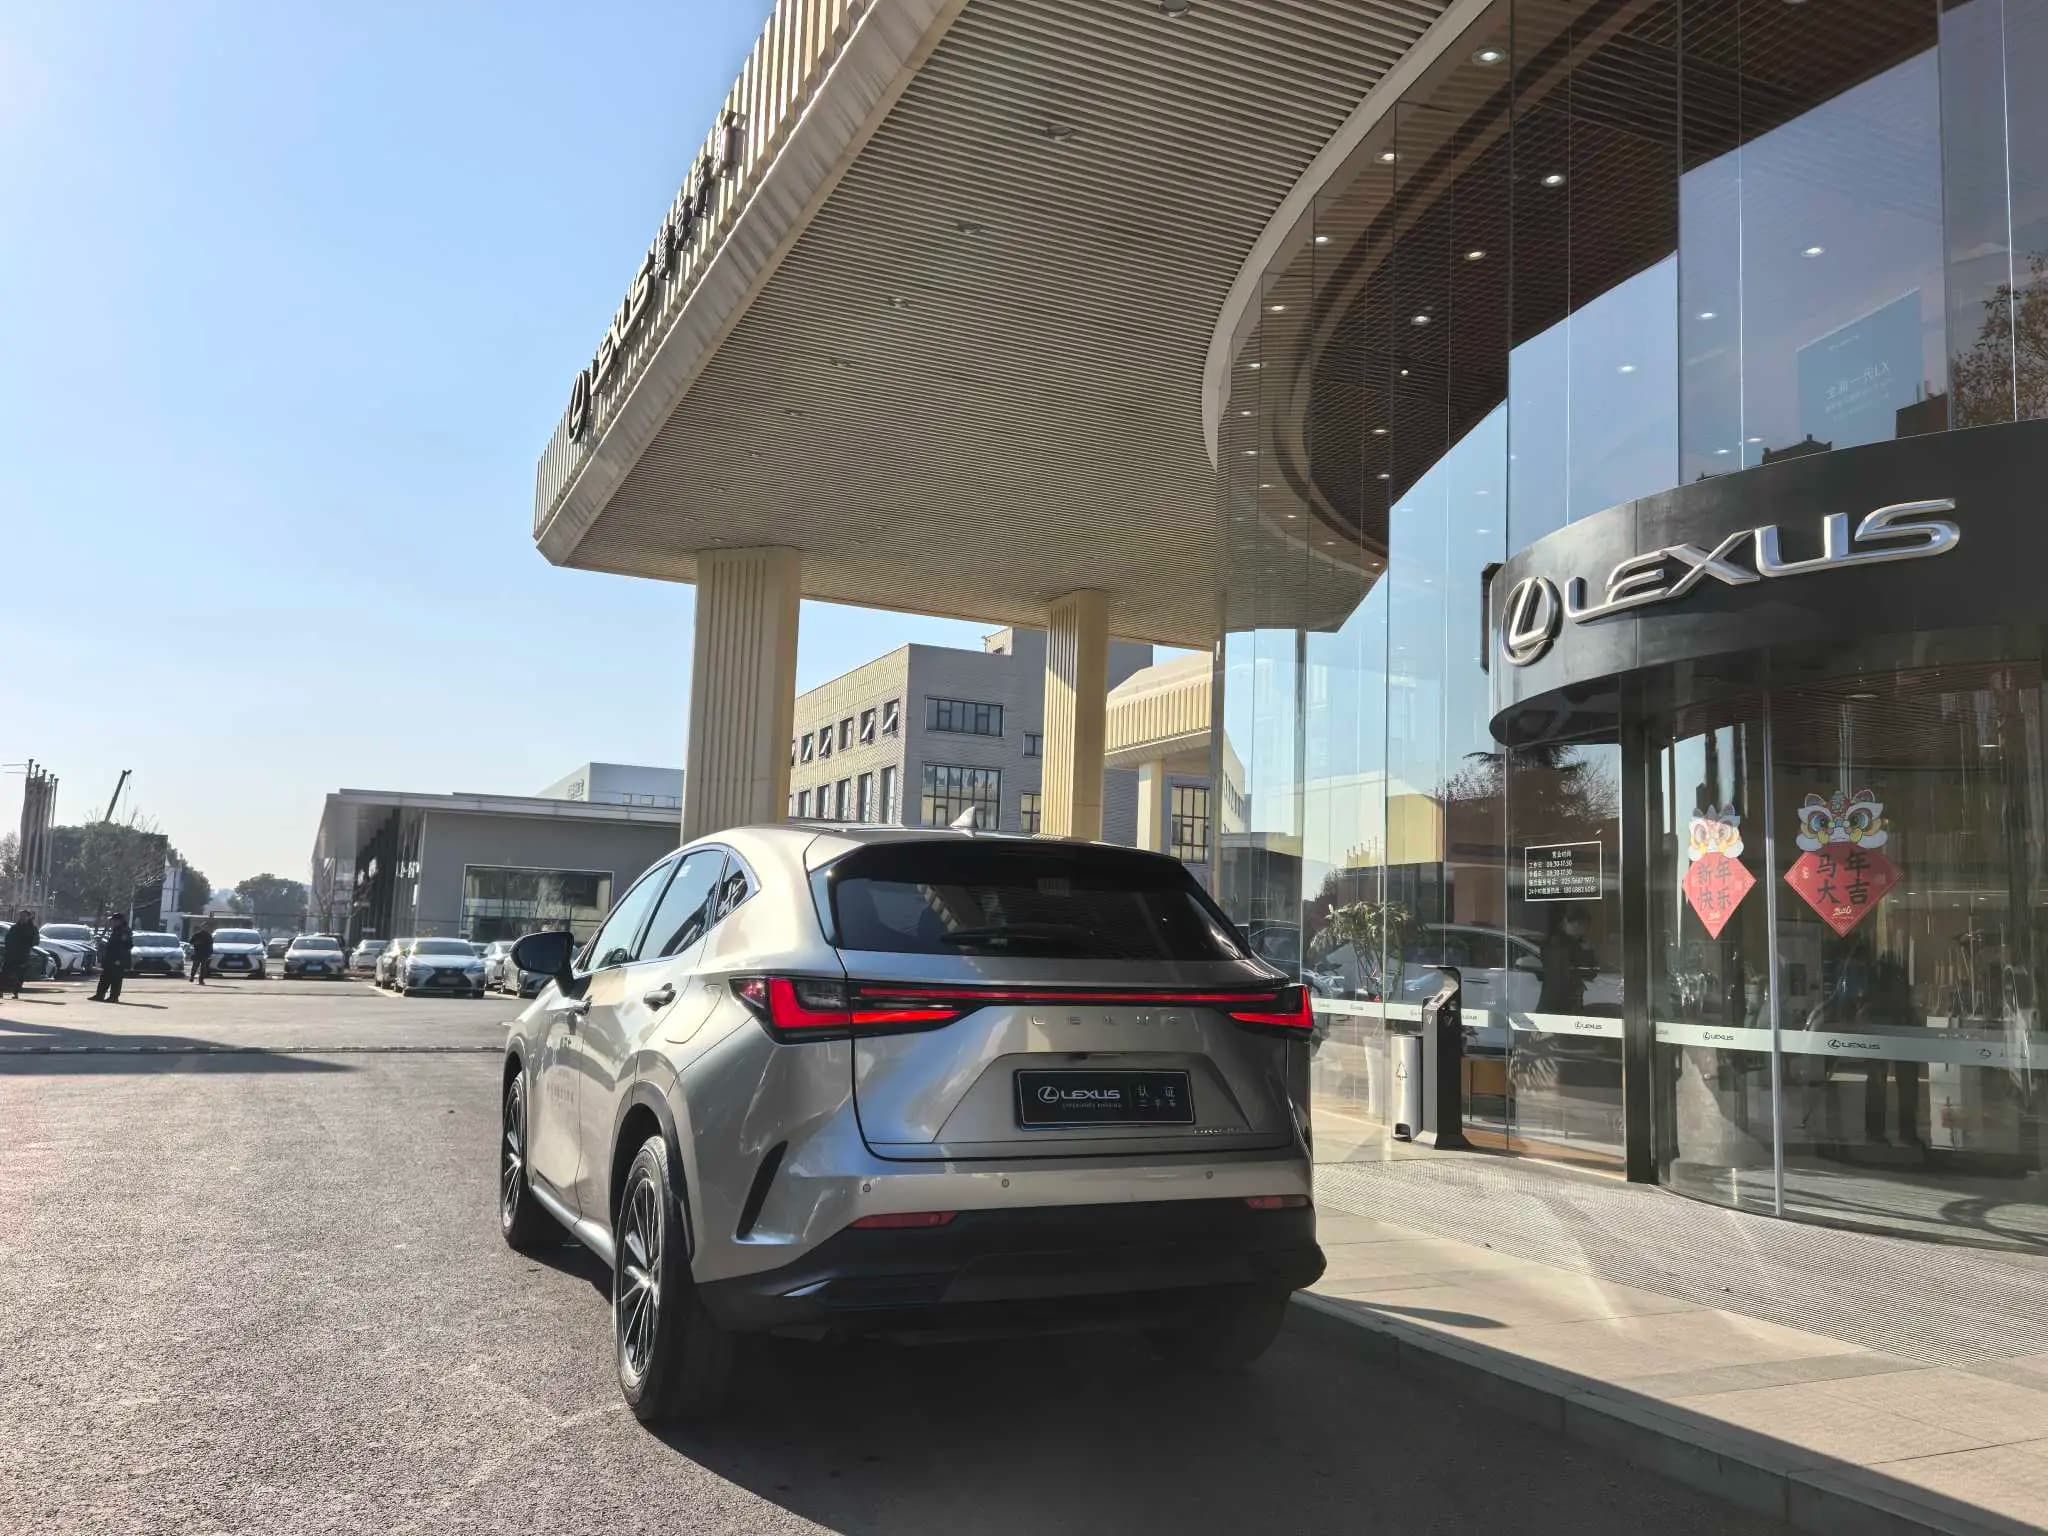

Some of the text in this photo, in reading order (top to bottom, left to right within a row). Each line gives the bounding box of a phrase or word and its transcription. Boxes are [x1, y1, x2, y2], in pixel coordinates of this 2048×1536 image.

[1565, 498, 1961, 625] LEXUS
[1697, 860, 1732, 886] 新年
[1816, 850, 1871, 879] 马年
[1697, 886, 1732, 911] 快乐
[1816, 880, 1871, 905] 大吉
[1060, 1089, 1121, 1100] LEXUS
